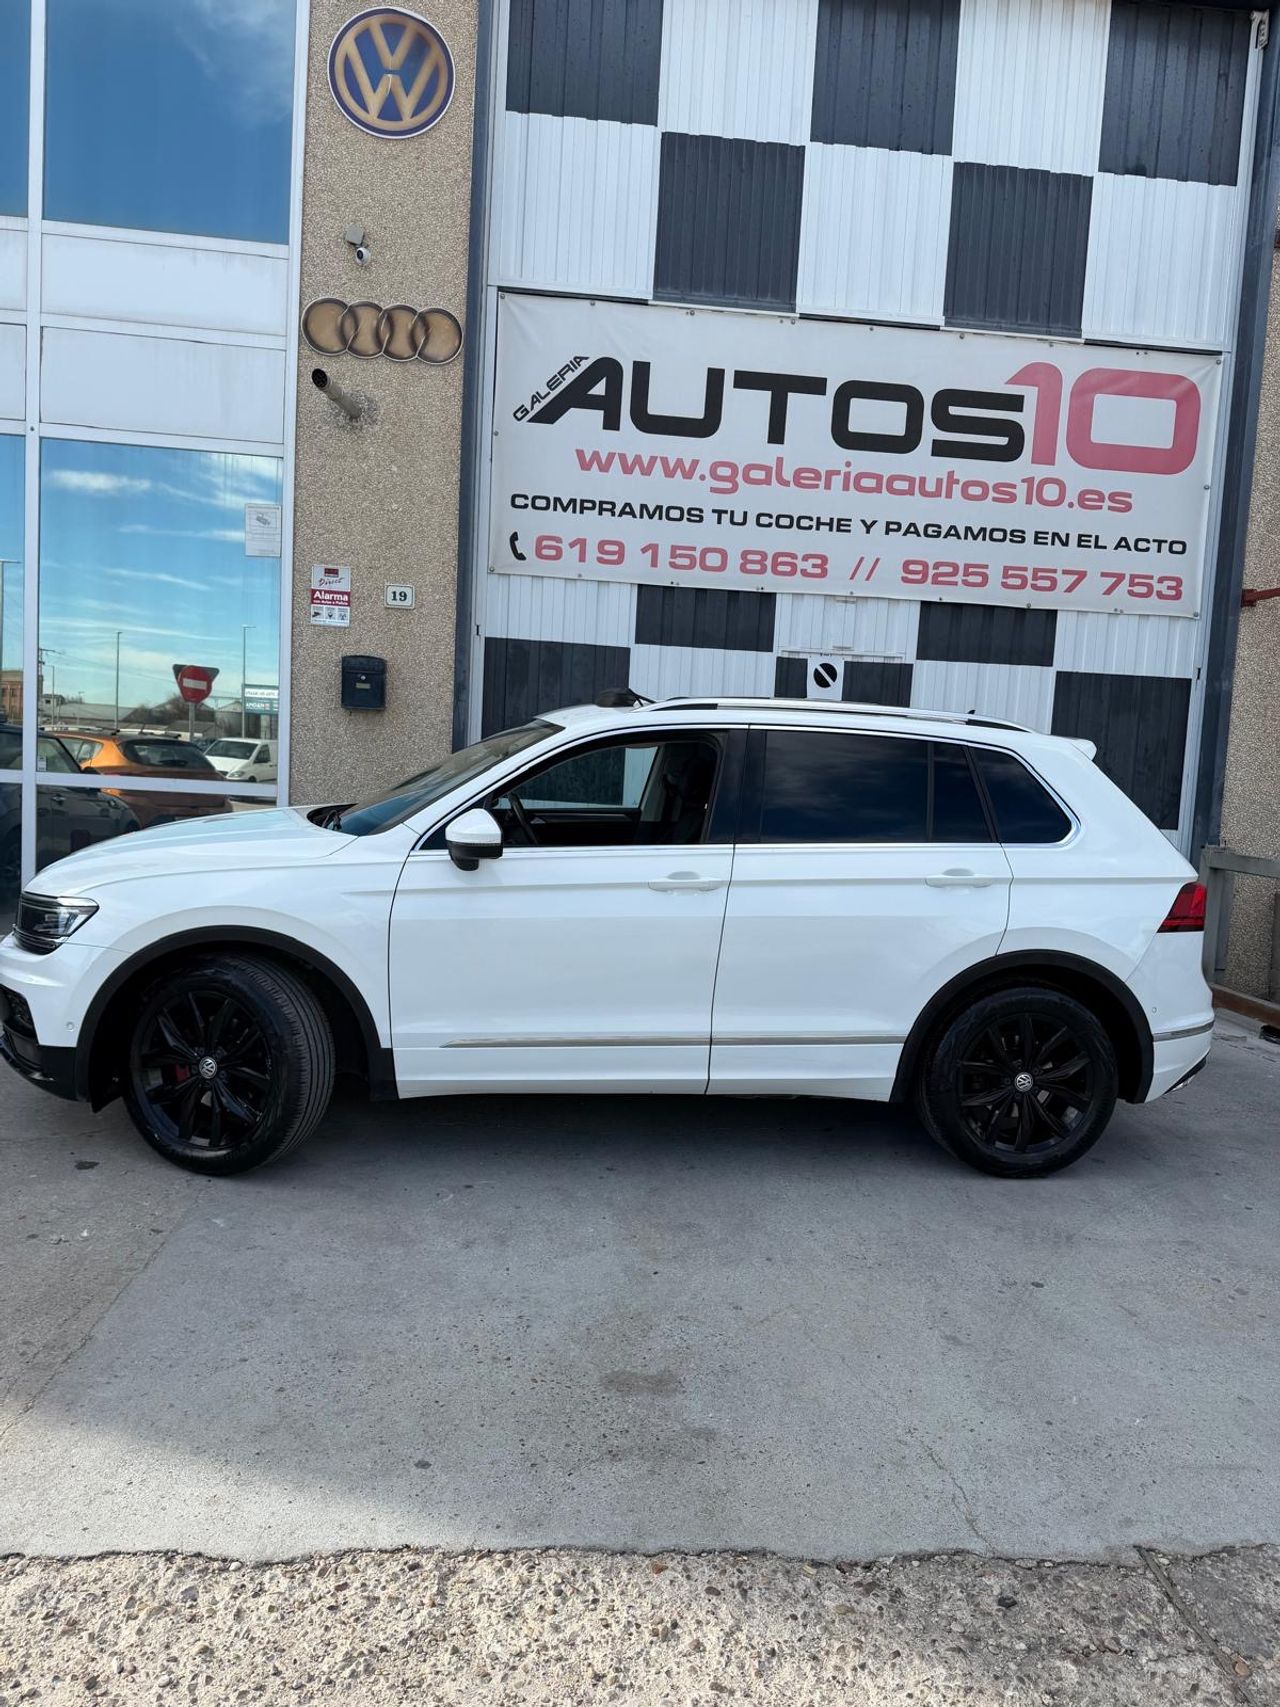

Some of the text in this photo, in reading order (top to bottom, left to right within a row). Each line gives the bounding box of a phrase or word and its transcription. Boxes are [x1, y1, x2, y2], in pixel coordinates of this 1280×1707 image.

[513, 355, 590, 422] GALERIA
[575, 448, 1133, 513] www.galeriaautos10.es
[510, 493, 1187, 555] COMPRAMOS TU COCHE Y PAGAMOS EN EL ACTO
[313, 590, 349, 602] Alarma
[391, 590, 408, 602] 19
[534, 534, 1184, 601] 619 150 863 // 925 557 753
